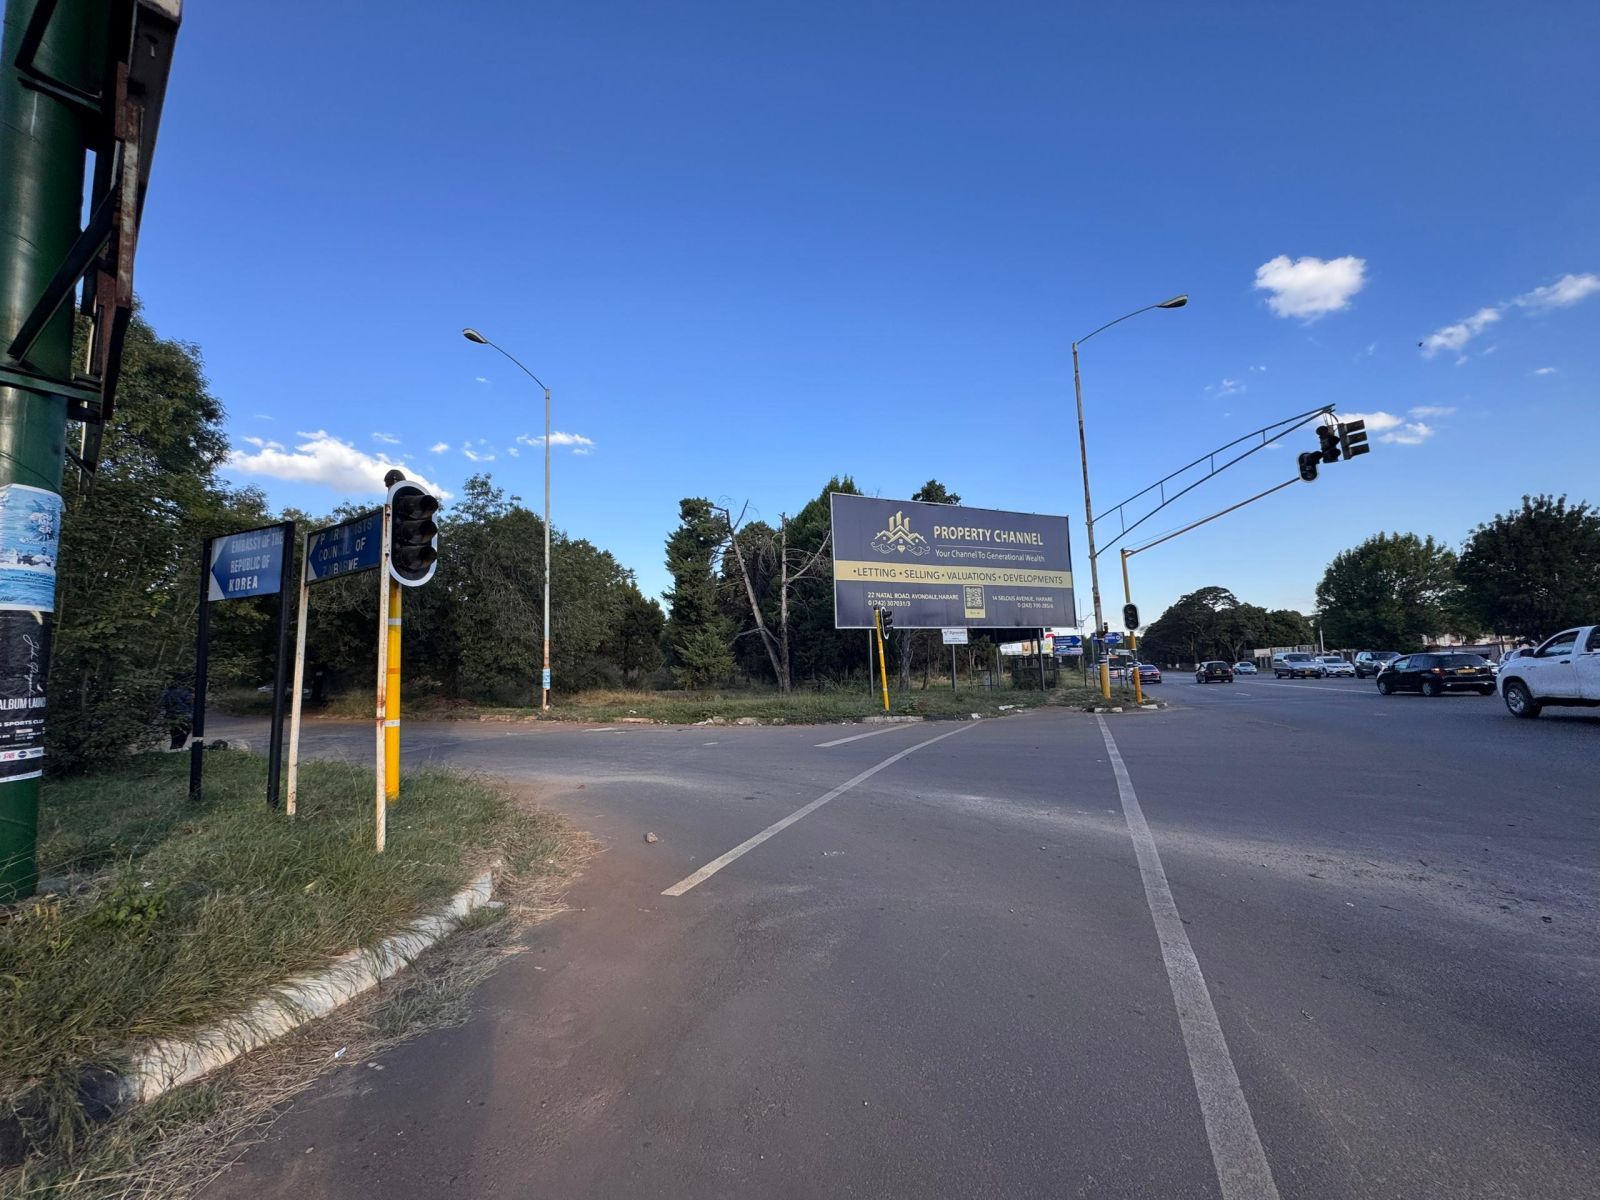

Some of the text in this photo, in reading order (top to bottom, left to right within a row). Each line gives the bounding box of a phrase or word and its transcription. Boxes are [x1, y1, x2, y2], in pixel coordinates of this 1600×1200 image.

[232, 537, 261, 553] EMBASSY
[262, 535, 271, 548] OF
[934, 526, 1044, 545] PROPERTY CHANNEL
[318, 536, 366, 562] CONIL OF
[935, 549, 1045, 562] Your Channel To Generational Wealth
[230, 554, 271, 574] REPUBLIC OF
[228, 575, 258, 592] KOREA
[857, 567, 1063, 585] LETTING SELLING VALUATIONS DEVELOPMENTS
[0, 697, 27, 711] ALBUM
[4, 719, 32, 727] SPORTS
